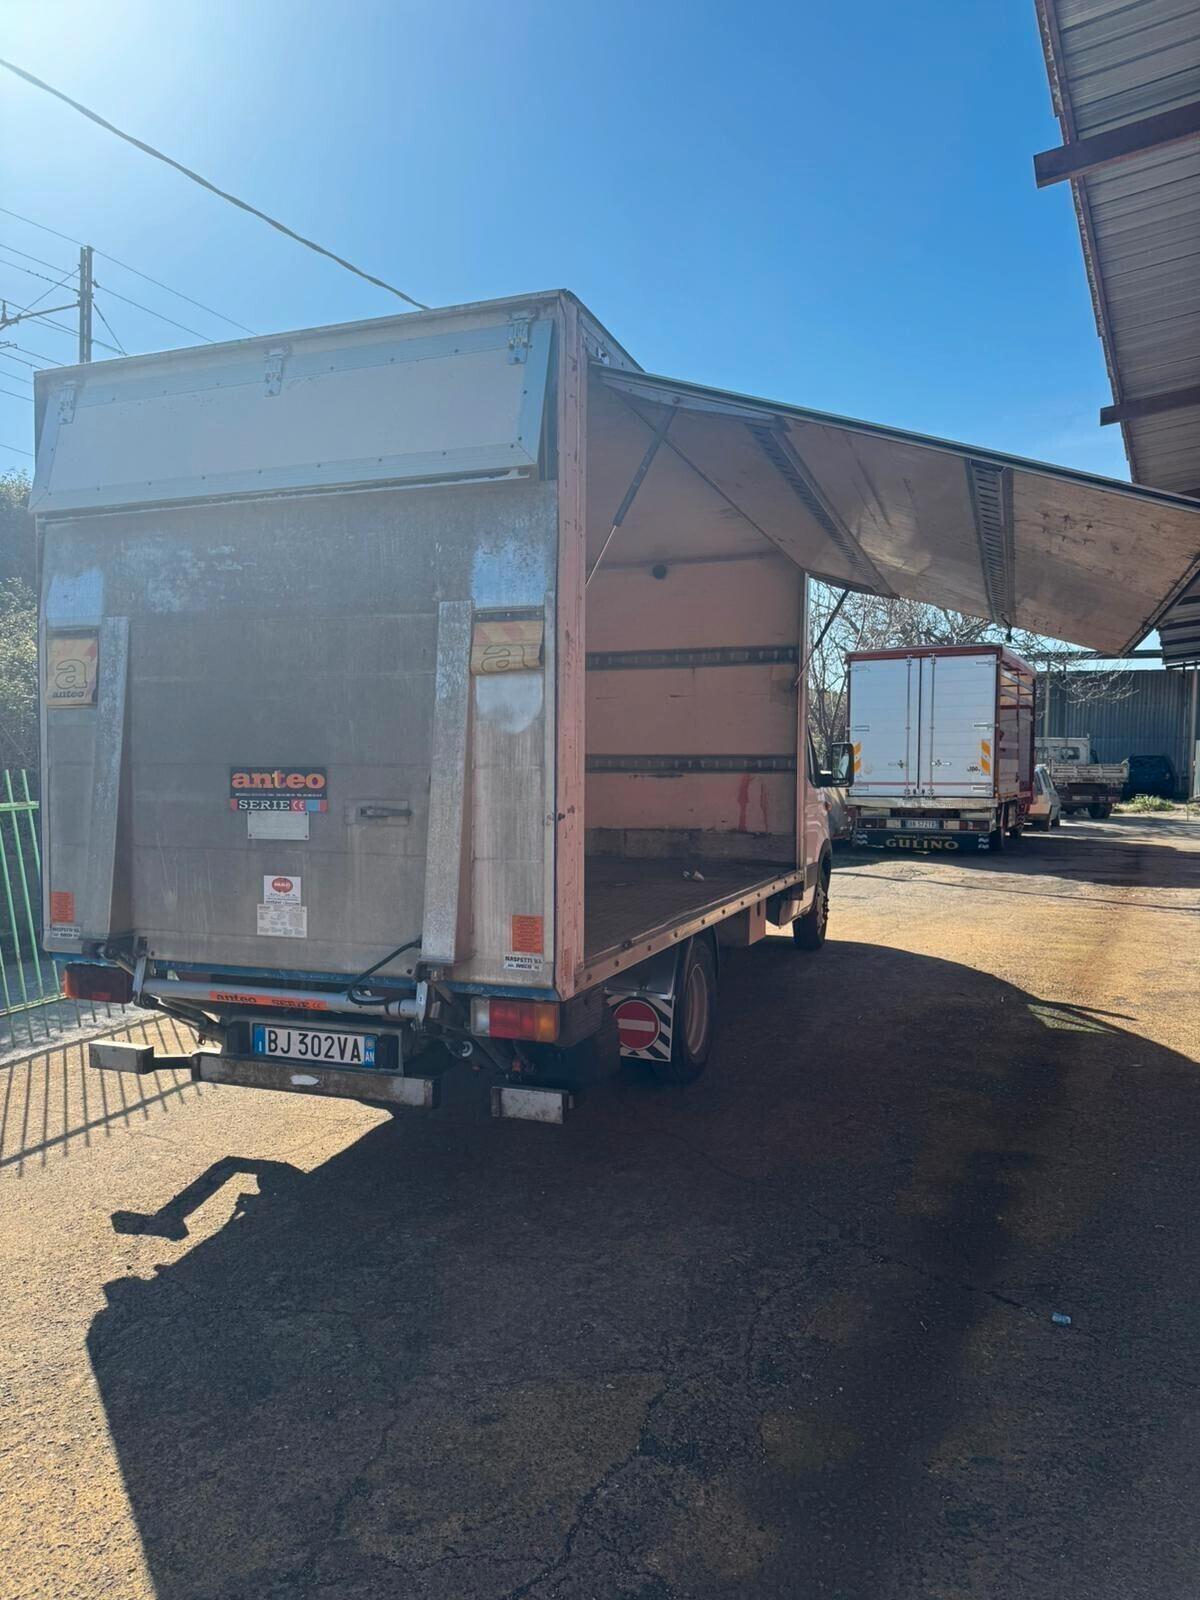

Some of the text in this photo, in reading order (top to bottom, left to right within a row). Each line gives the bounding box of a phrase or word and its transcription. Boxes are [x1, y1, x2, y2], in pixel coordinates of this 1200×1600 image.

[55, 659, 88, 690] a
[231, 770, 325, 789] anteo
[238, 800, 290, 810] SERIE
[886, 839, 958, 849] GULINO
[216, 993, 257, 1003] anteo
[365, 1051, 376, 1062] AN
